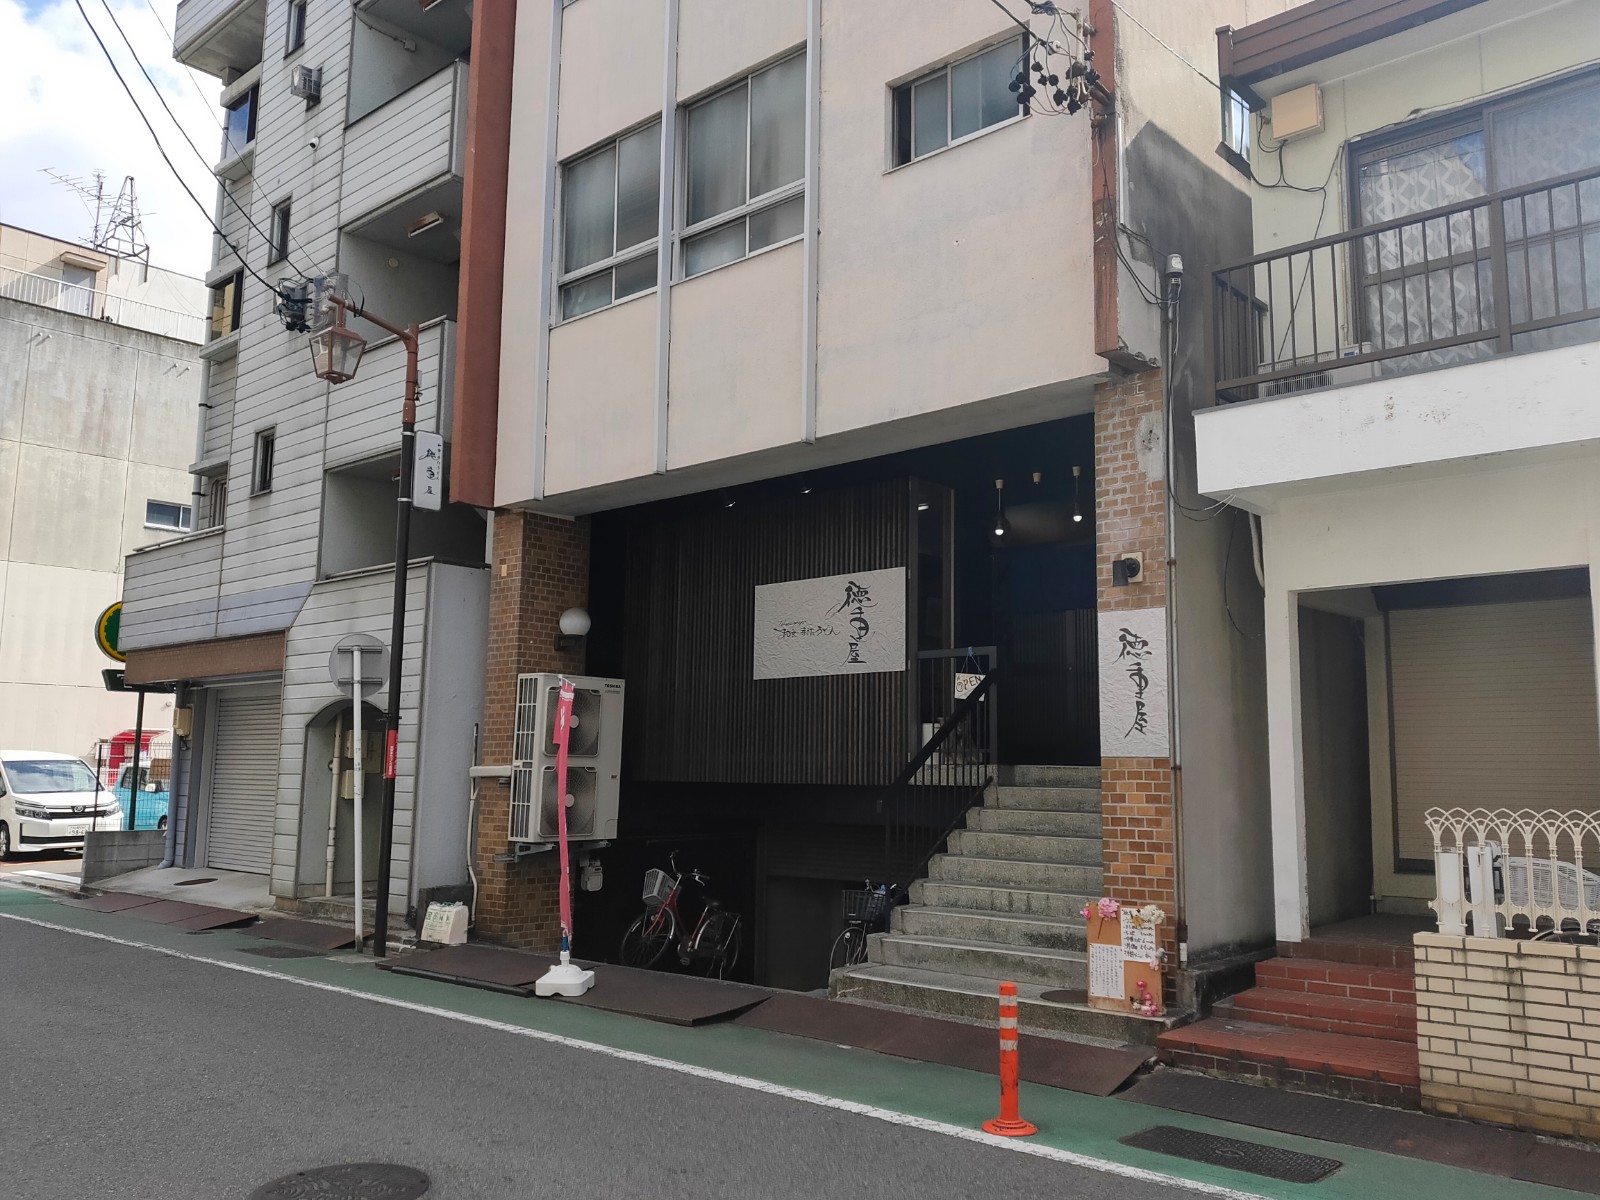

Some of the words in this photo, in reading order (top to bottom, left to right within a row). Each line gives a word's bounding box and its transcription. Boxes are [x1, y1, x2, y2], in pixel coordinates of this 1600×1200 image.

[829, 580, 879, 667] 徳重屋
[1112, 627, 1153, 739] 徳重屋
